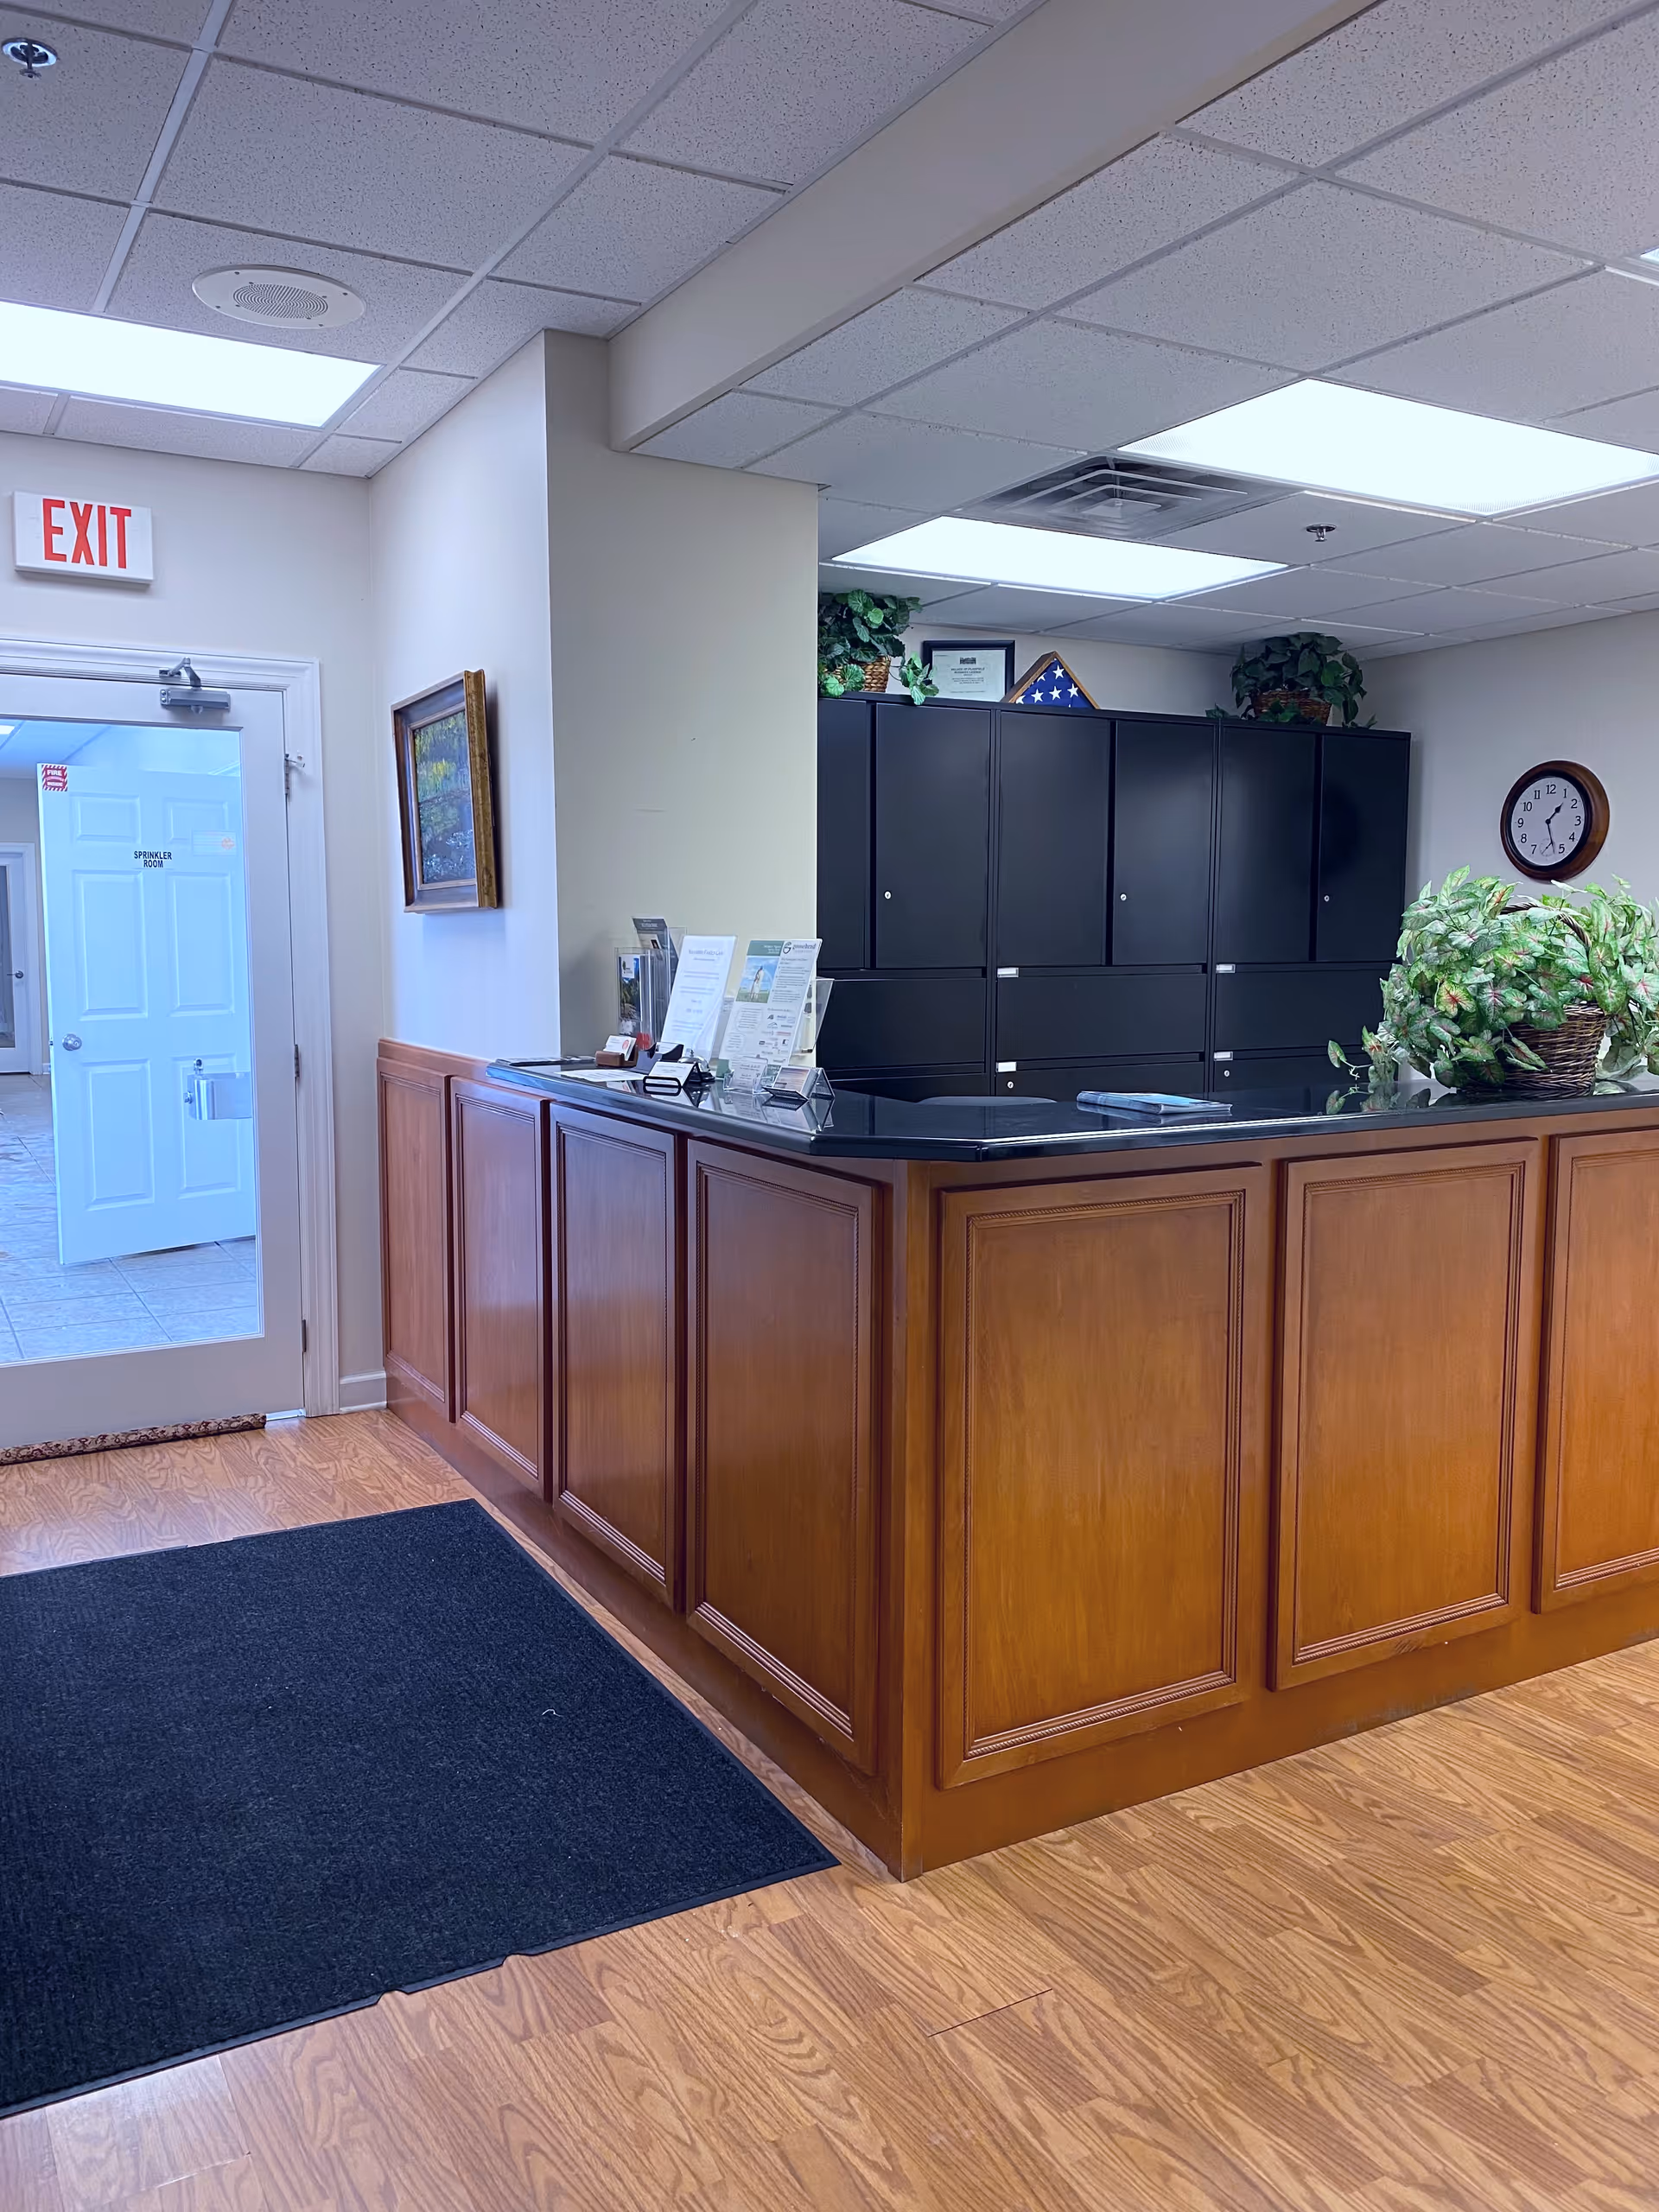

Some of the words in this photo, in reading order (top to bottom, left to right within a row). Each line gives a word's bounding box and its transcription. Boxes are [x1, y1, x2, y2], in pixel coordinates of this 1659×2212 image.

[42, 498, 132, 569] EXIT
[1534, 790, 1541, 799] 11
[1546, 784, 1556, 795] 12
[1563, 788, 1567, 798] 1
[1523, 801, 1533, 811] 10
[1571, 798, 1578, 809] 2
[1517, 817, 1524, 828] 9
[1574, 816, 1581, 826] 3
[1521, 833, 1527, 843] 8
[1568, 832, 1575, 842] 4
[1531, 844, 1537, 854] 7
[1558, 843, 1565, 854] 5
[134, 850, 173, 860] SPRINKLER
[143, 860, 164, 868] ROOM
